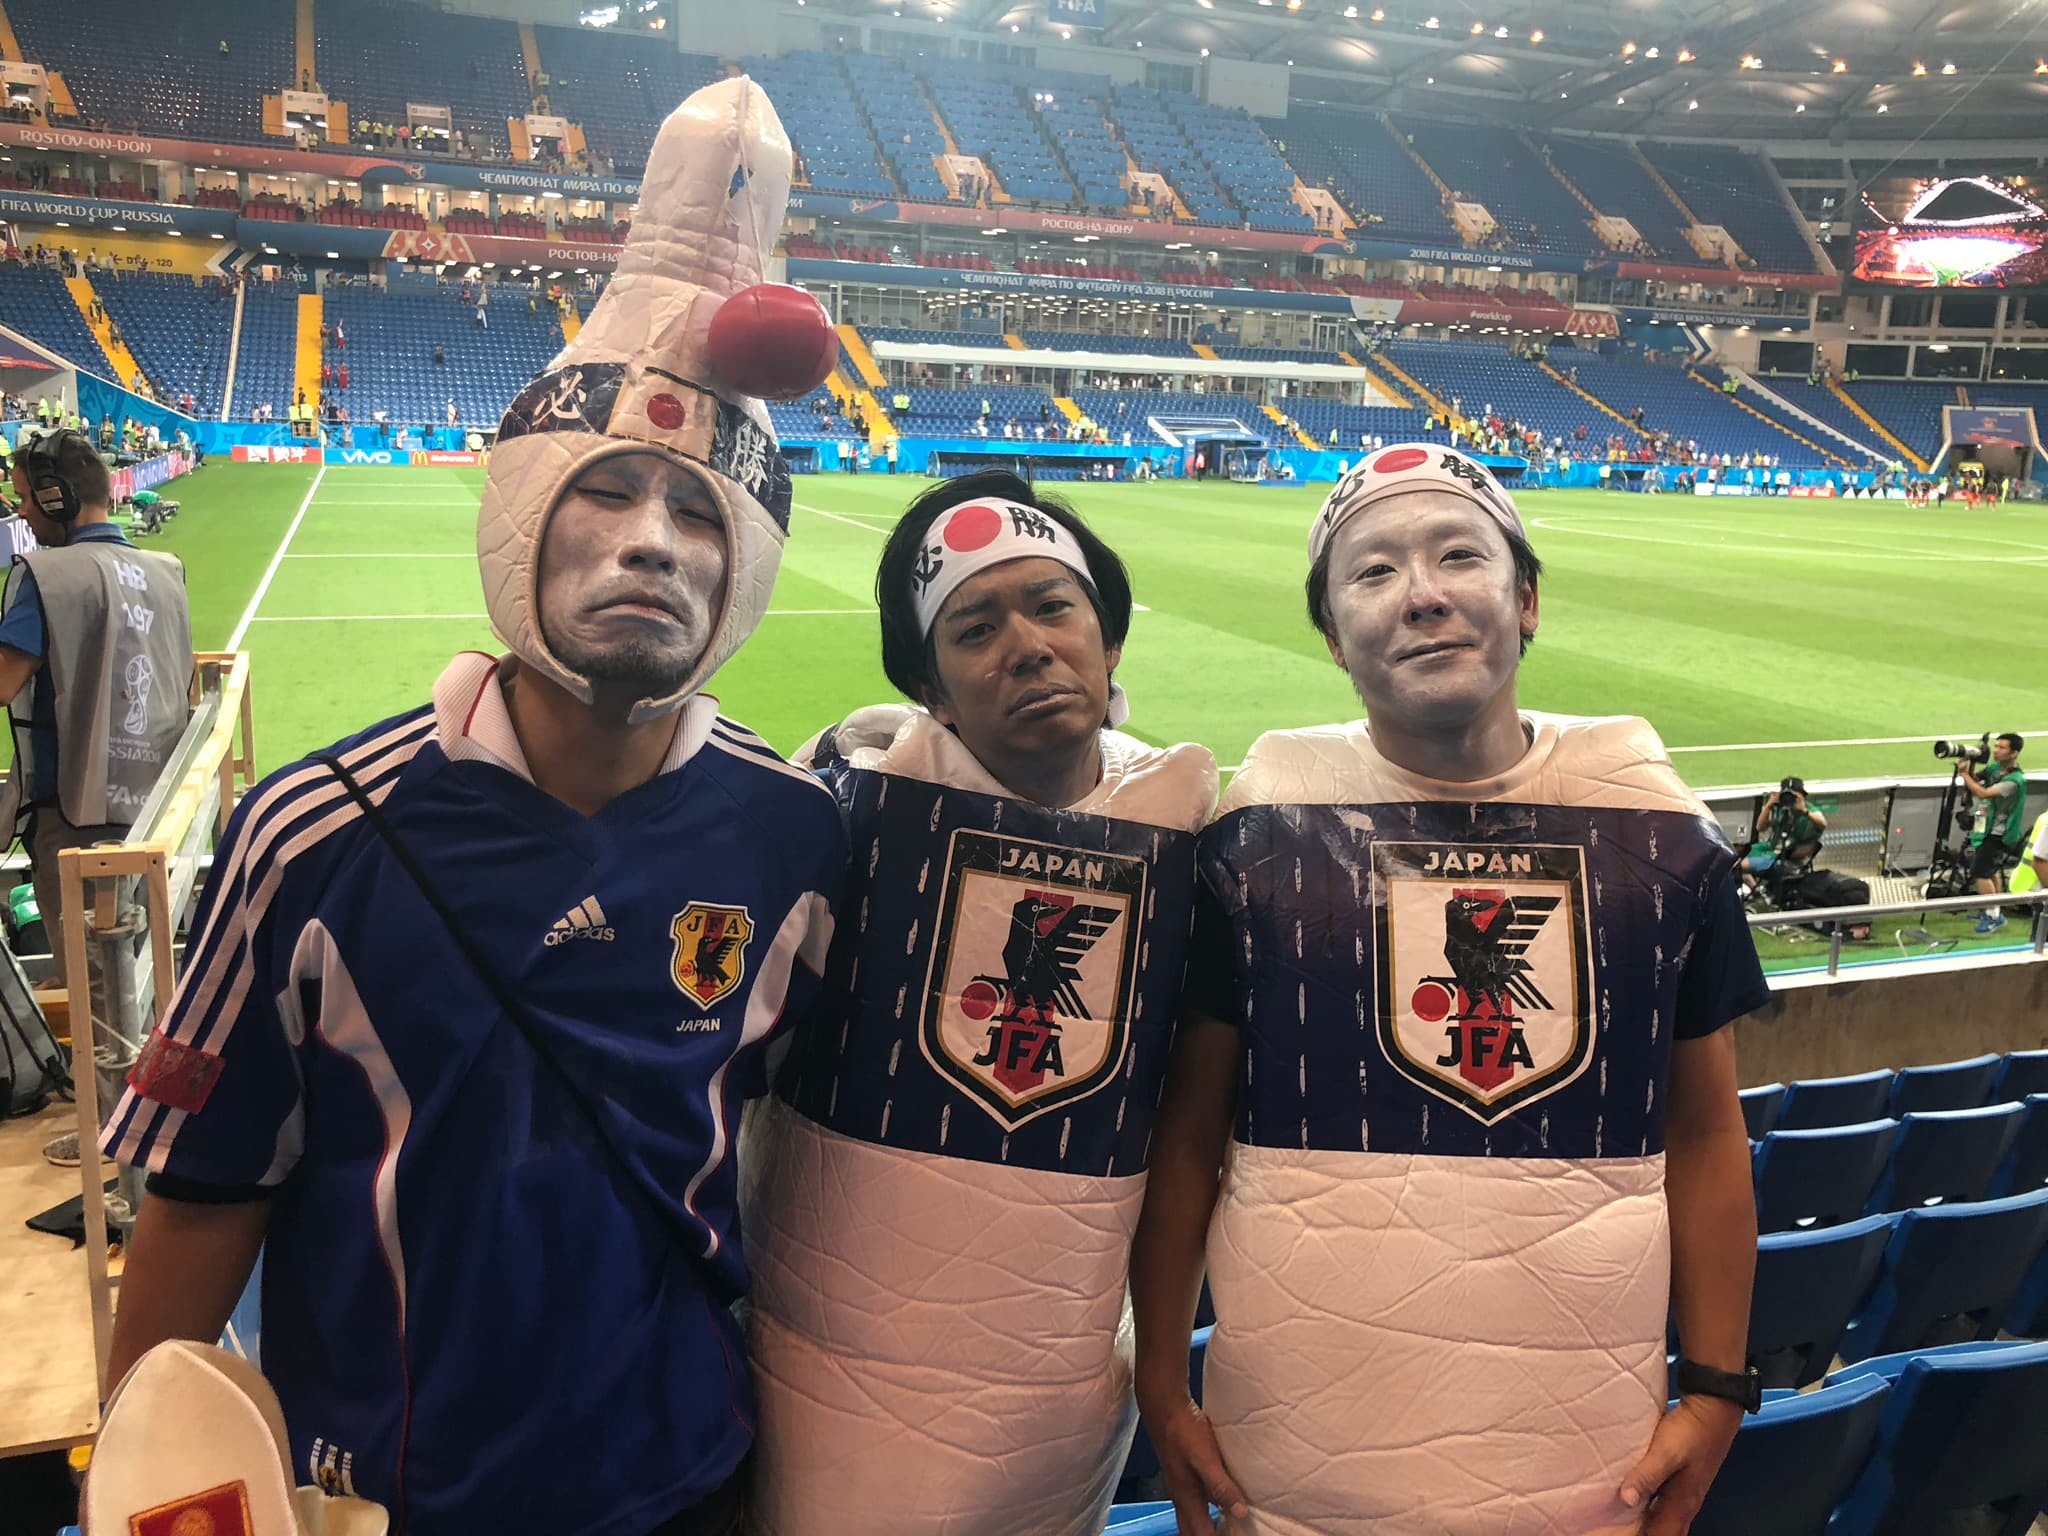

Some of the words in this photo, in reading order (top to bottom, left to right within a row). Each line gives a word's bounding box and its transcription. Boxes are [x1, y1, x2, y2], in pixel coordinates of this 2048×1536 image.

[1058, 0, 1096, 13] FIFA
[20, 130, 152, 153] ROSTOV-ON-DON
[479, 172, 560, 189] ЧЕМПИОНАТ
[563, 180, 600, 192] МИРА
[603, 182, 622, 194] ПО
[1, 200, 32, 213] FIFA
[36, 202, 87, 217] WORLD
[88, 207, 119, 220] CUP
[121, 210, 174, 224] RUSSIA
[1042, 218, 1134, 234] РОСТОВ-НА-ДОНУ
[1410, 249, 1430, 258] 2018
[1431, 251, 1449, 260] FIFA
[1451, 252, 1482, 263] WORLD
[1483, 255, 1501, 265] CUP
[1501, 256, 1533, 267] RUSSIA
[961, 274, 1023, 286] ЧЕМПИОНАТ
[1027, 279, 1057, 289] МИРА
[1059, 281, 1074, 290] ПО
[1076, 282, 1121, 294] ФУТБОЛУ
[1122, 286, 1143, 294] FIFA
[1144, 287, 1166, 297] 2018
[1470, 310, 1512, 323] #worldcup
[532, 371, 588, 427] 必
[911, 544, 944, 600] 必
[1006, 506, 1056, 544] 勝
[113, 559, 148, 592] HB
[1002, 847, 1104, 882] JAPAN
[1423, 851, 1532, 873] JAPAN
[687, 914, 740, 936] JFA
[543, 926, 616, 947] adidas
[676, 1017, 721, 1032] JAPAN
[973, 1026, 1065, 1077] JFA
[1436, 1026, 1536, 1069] JFA
